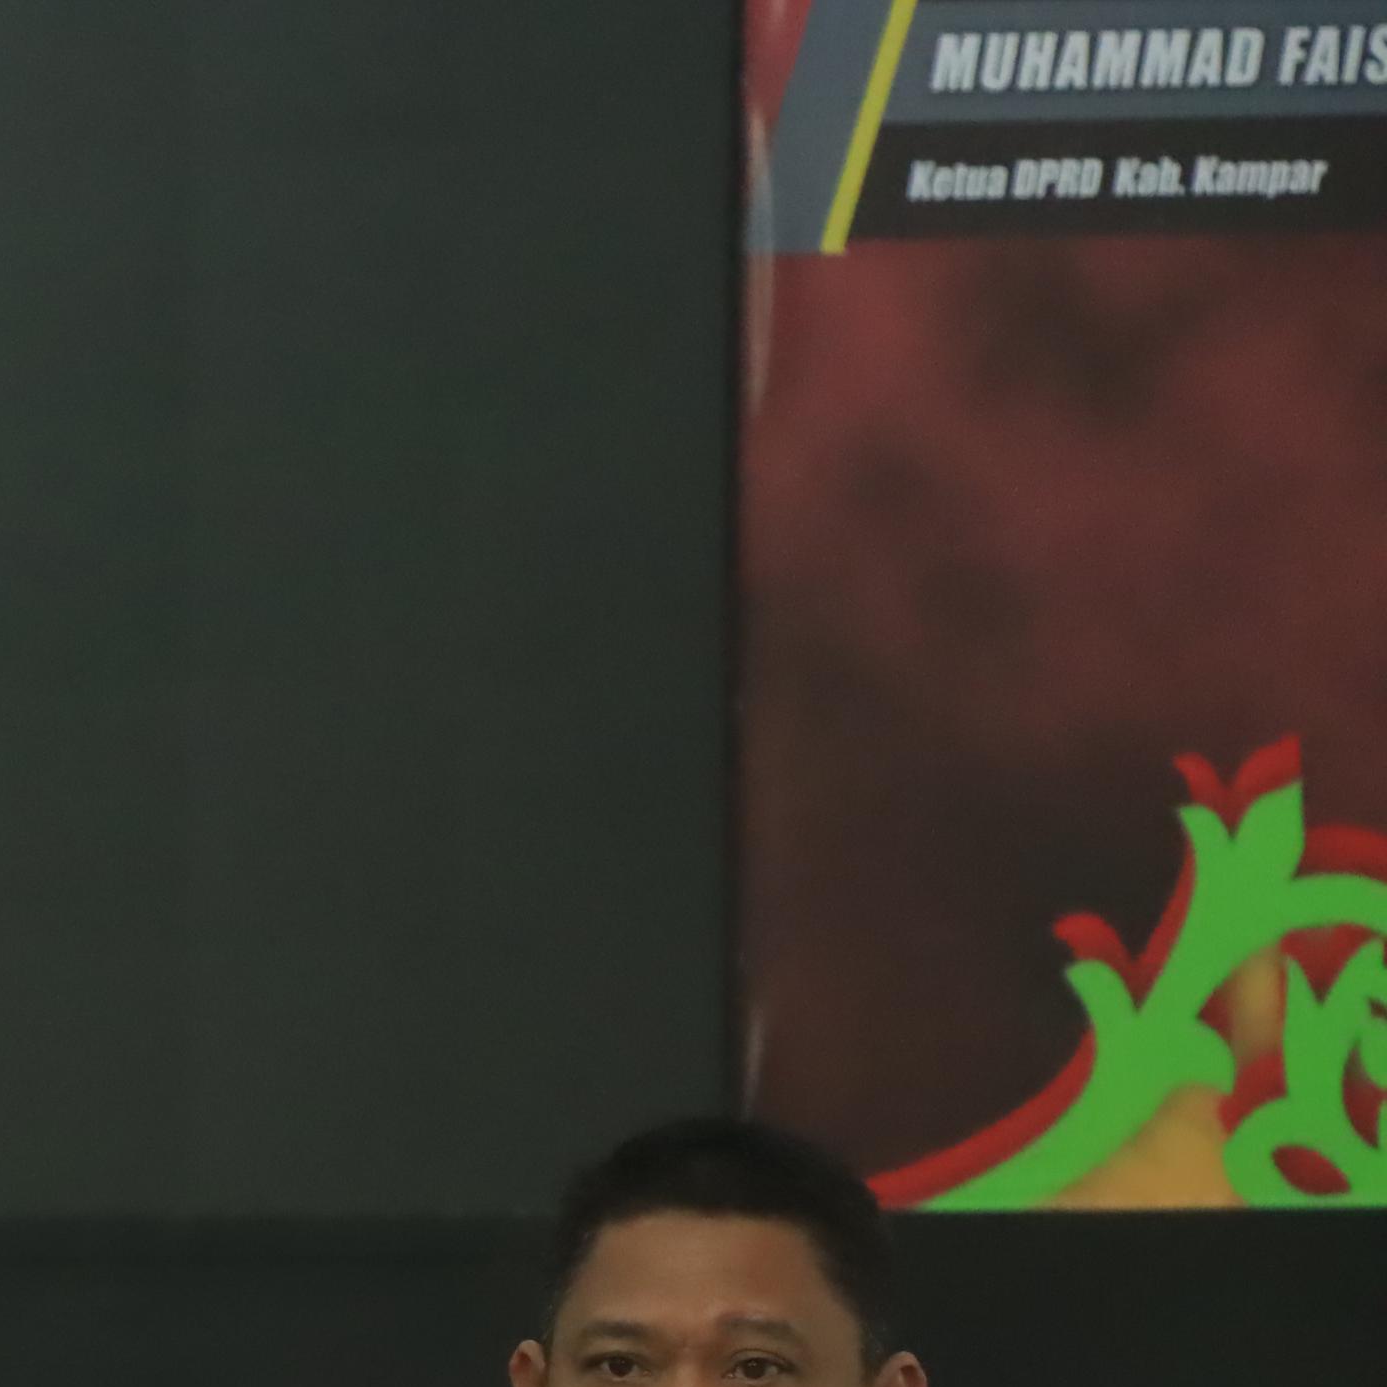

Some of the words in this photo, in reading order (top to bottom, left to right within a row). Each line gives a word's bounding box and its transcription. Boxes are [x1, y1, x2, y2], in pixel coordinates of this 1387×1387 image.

[930, 27, 1266, 92] MUHAMMAD
[906, 160, 1009, 201] Ketua
[1011, 158, 1104, 199] DPRD
[1112, 155, 1186, 197] Kab.
[1191, 155, 1329, 200] Kampar
